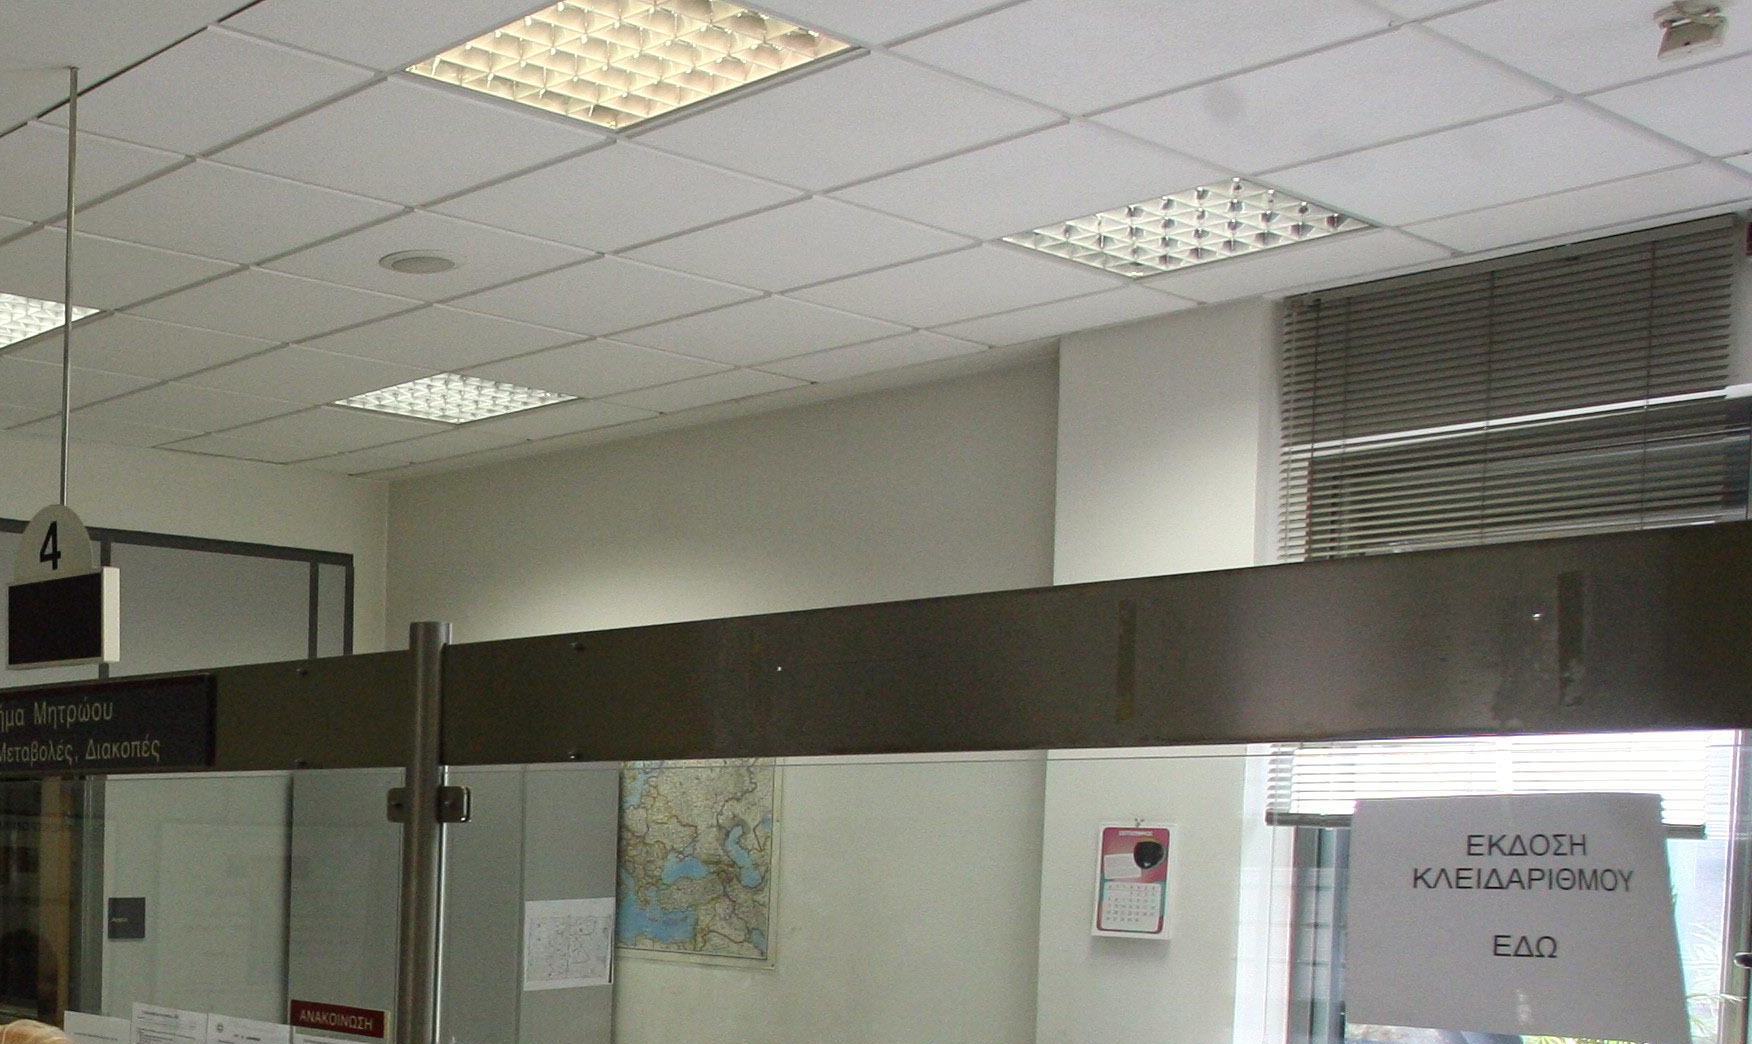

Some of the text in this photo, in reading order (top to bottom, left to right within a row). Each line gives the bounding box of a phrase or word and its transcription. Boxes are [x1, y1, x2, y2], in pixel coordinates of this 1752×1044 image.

[39, 520, 62, 570] 4
[33, 697, 114, 730] Μητρώου
[85, 734, 161, 762] Διακοπές
[1465, 831, 1588, 857] ΕΚΔΟΣΗ
[1412, 865, 1634, 893] ΚΛΕΙΔΑΡΙΘΜΟΥ
[1490, 933, 1558, 959] ΕΔΩ
[298, 1009, 373, 1031] ΑΝΑΚΟΙΝΩΣΗ
